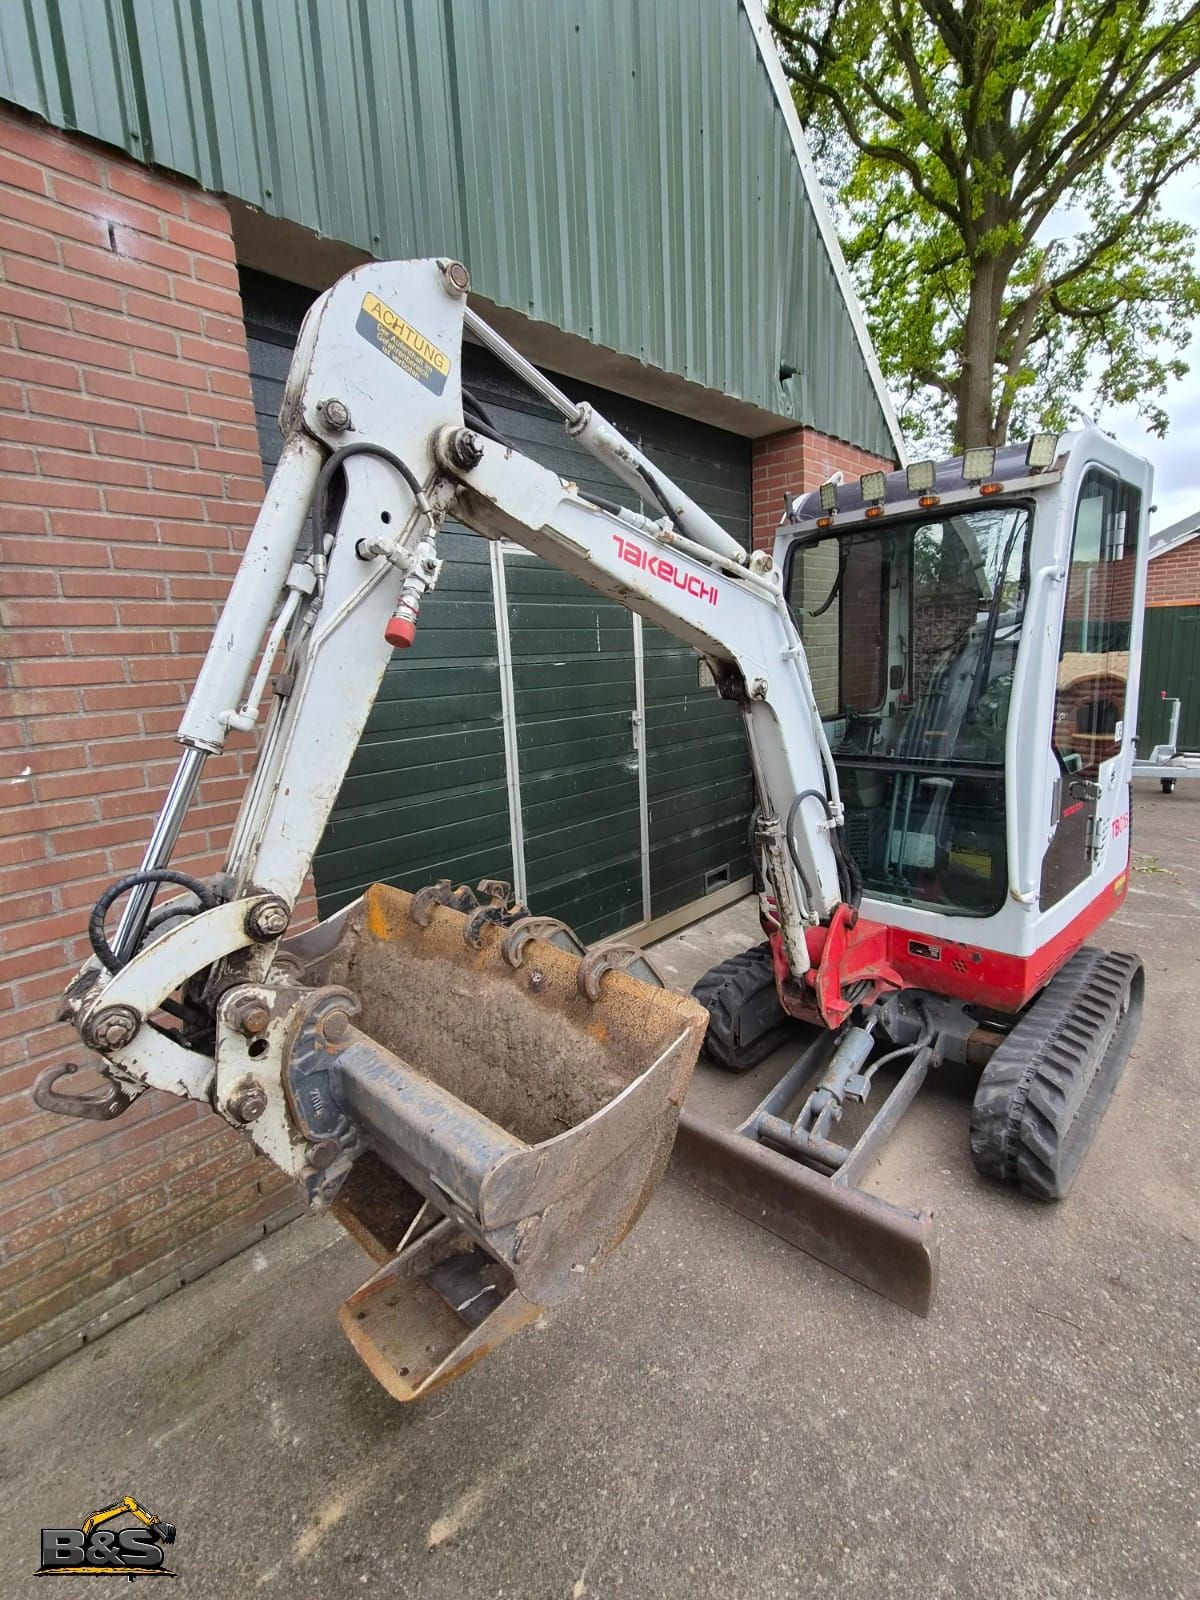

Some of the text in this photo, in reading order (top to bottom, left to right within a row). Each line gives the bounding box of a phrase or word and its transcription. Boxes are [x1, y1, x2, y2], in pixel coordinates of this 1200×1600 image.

[371, 302, 444, 369] ACHTUNG
[376, 322, 389, 338] Der
[376, 331, 429, 379] Gefahrenbereich
[381, 344, 419, 379] ist verboten
